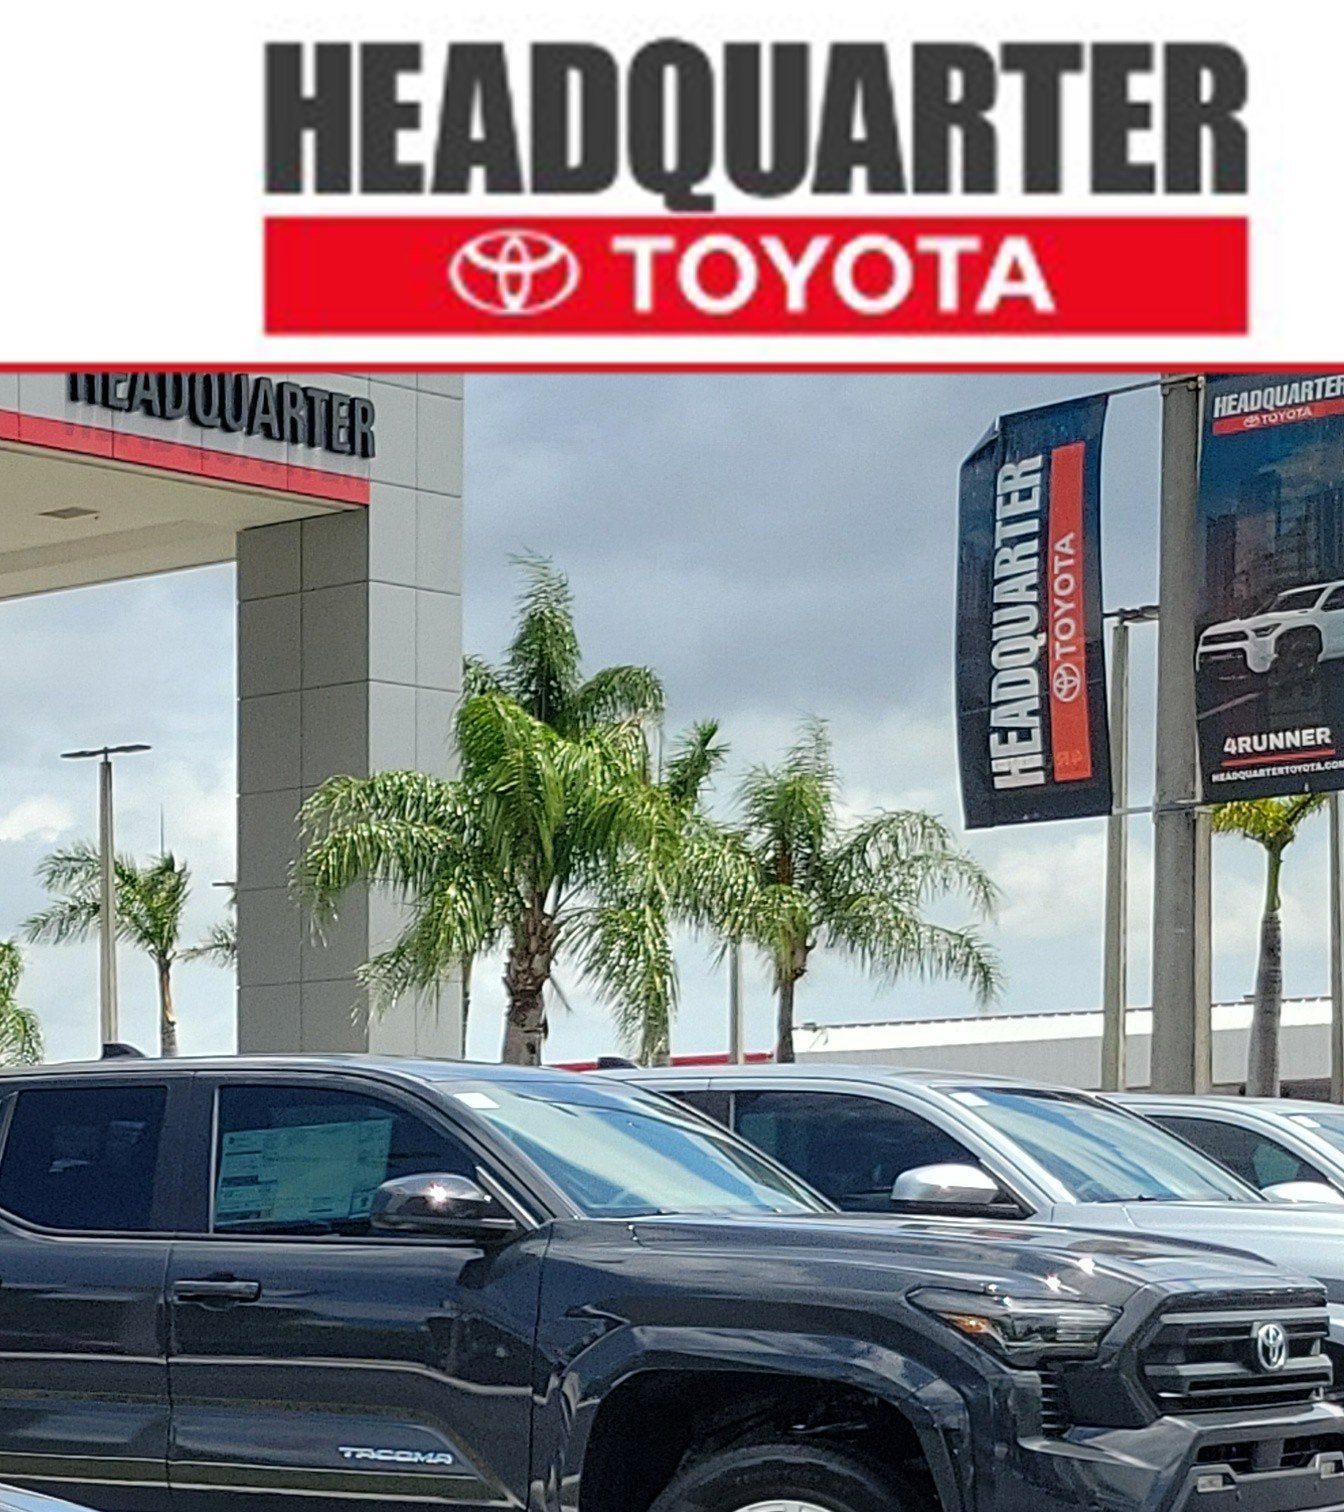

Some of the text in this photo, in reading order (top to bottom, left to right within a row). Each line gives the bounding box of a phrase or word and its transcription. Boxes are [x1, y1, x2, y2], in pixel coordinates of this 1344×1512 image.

[1261, 406, 1312, 425] TOYOTA
[1054, 531, 1076, 660] TOYOTA
[989, 454, 1047, 790] HEADQUARTER
[1223, 727, 1332, 755] 4RUNNER
[338, 1446, 452, 1465] TACOMA
